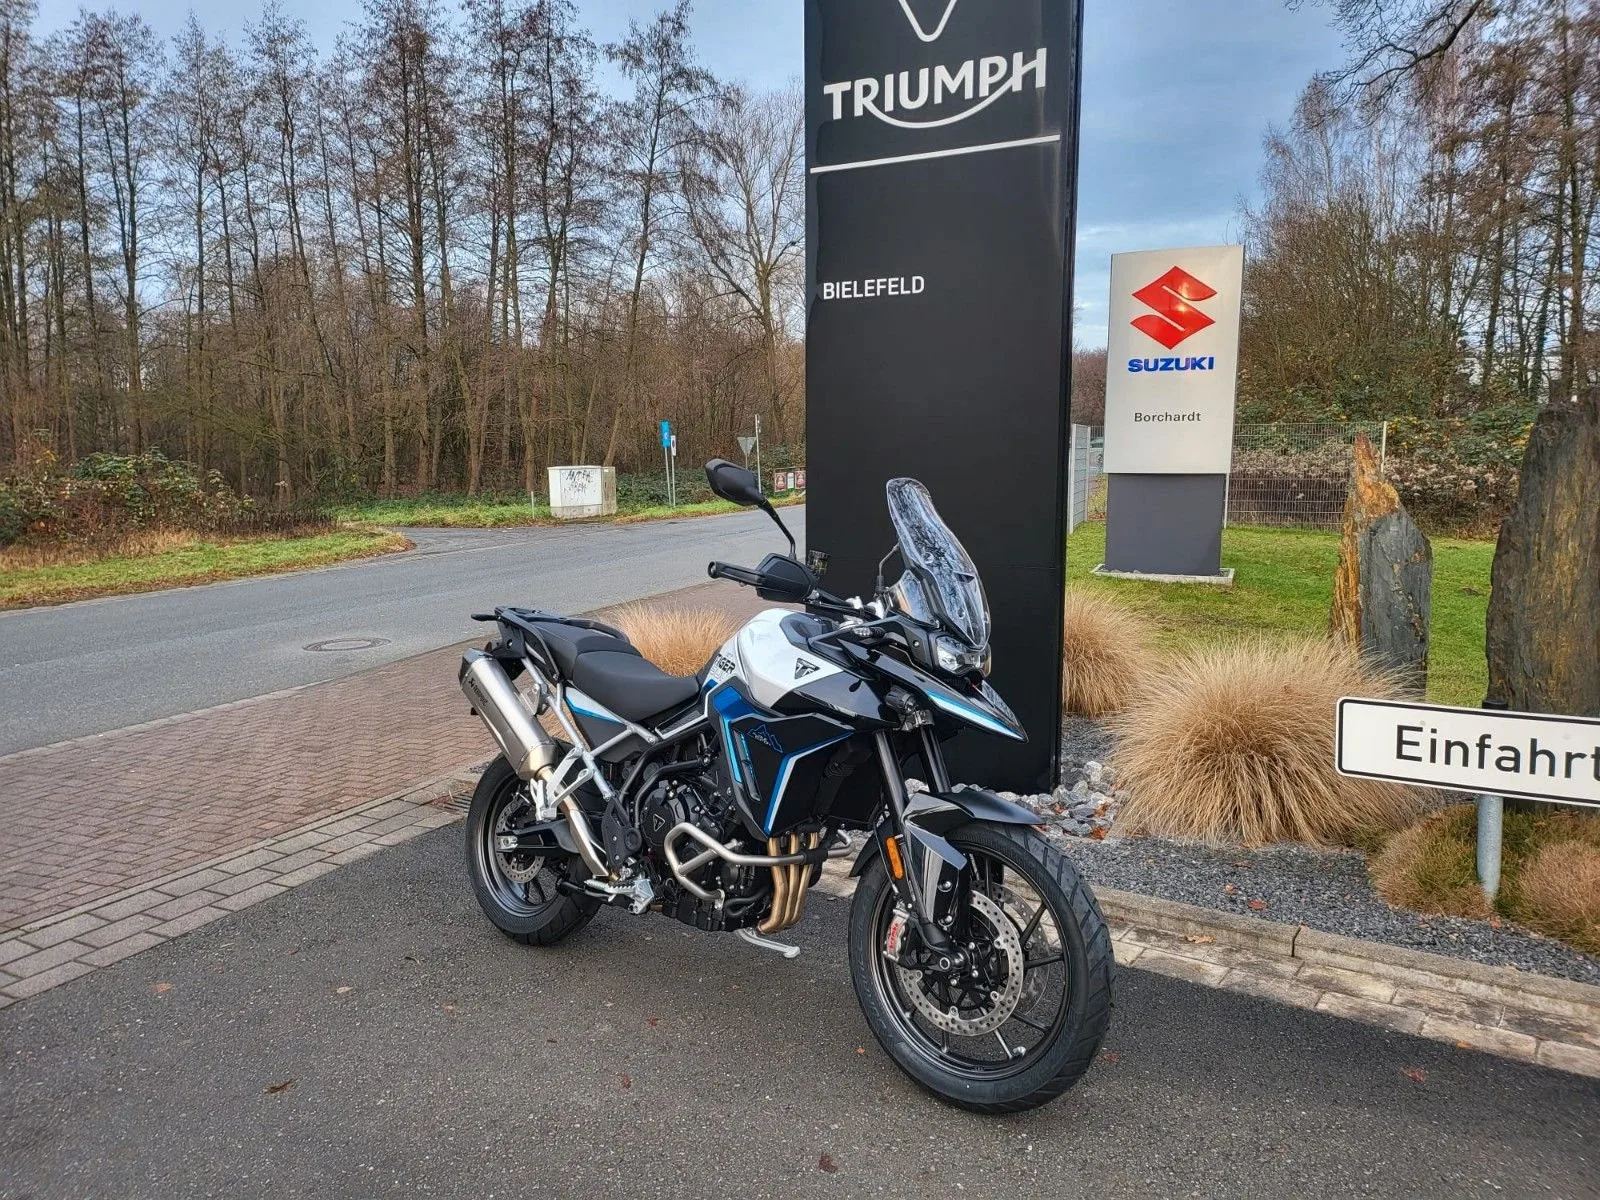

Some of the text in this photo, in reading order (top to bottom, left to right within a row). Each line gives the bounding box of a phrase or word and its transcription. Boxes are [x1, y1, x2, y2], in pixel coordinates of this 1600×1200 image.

[824, 48, 1047, 128] TRIUMPH
[823, 276, 925, 300] BIELEFELD
[1128, 356, 1214, 372] SUZUKI
[1134, 411, 1201, 422] Borchardt
